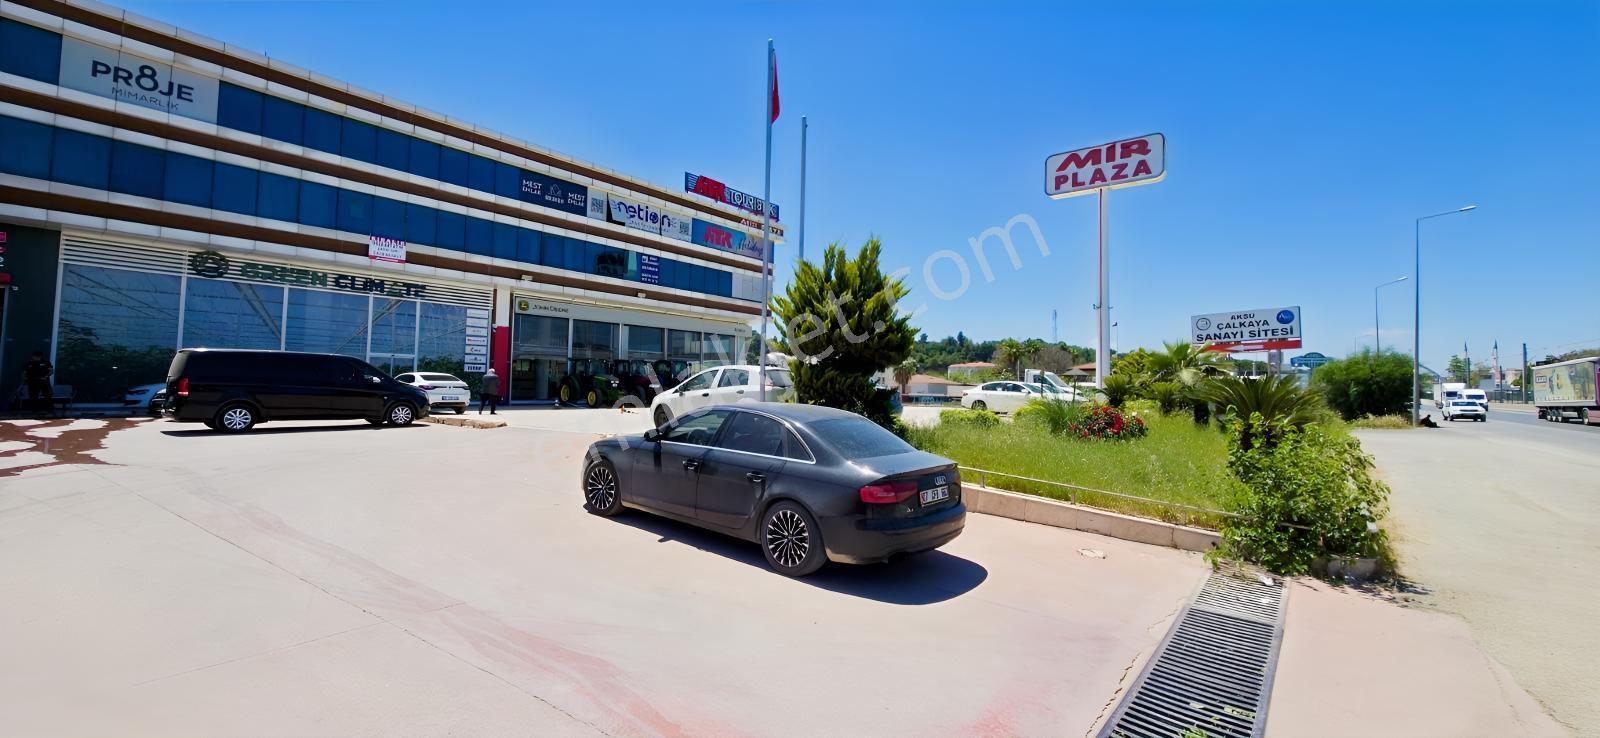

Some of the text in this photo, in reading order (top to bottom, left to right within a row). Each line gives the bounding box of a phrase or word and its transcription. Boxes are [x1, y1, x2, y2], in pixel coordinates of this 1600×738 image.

[1055, 138, 1152, 172] MIR
[1054, 159, 1153, 191] PLAZA
[240, 262, 329, 289] GREEN
[1216, 319, 1270, 332] ÇALKAYA
[1230, 312, 1255, 321] AKSU
[1248, 325, 1294, 338] SİTESİ
